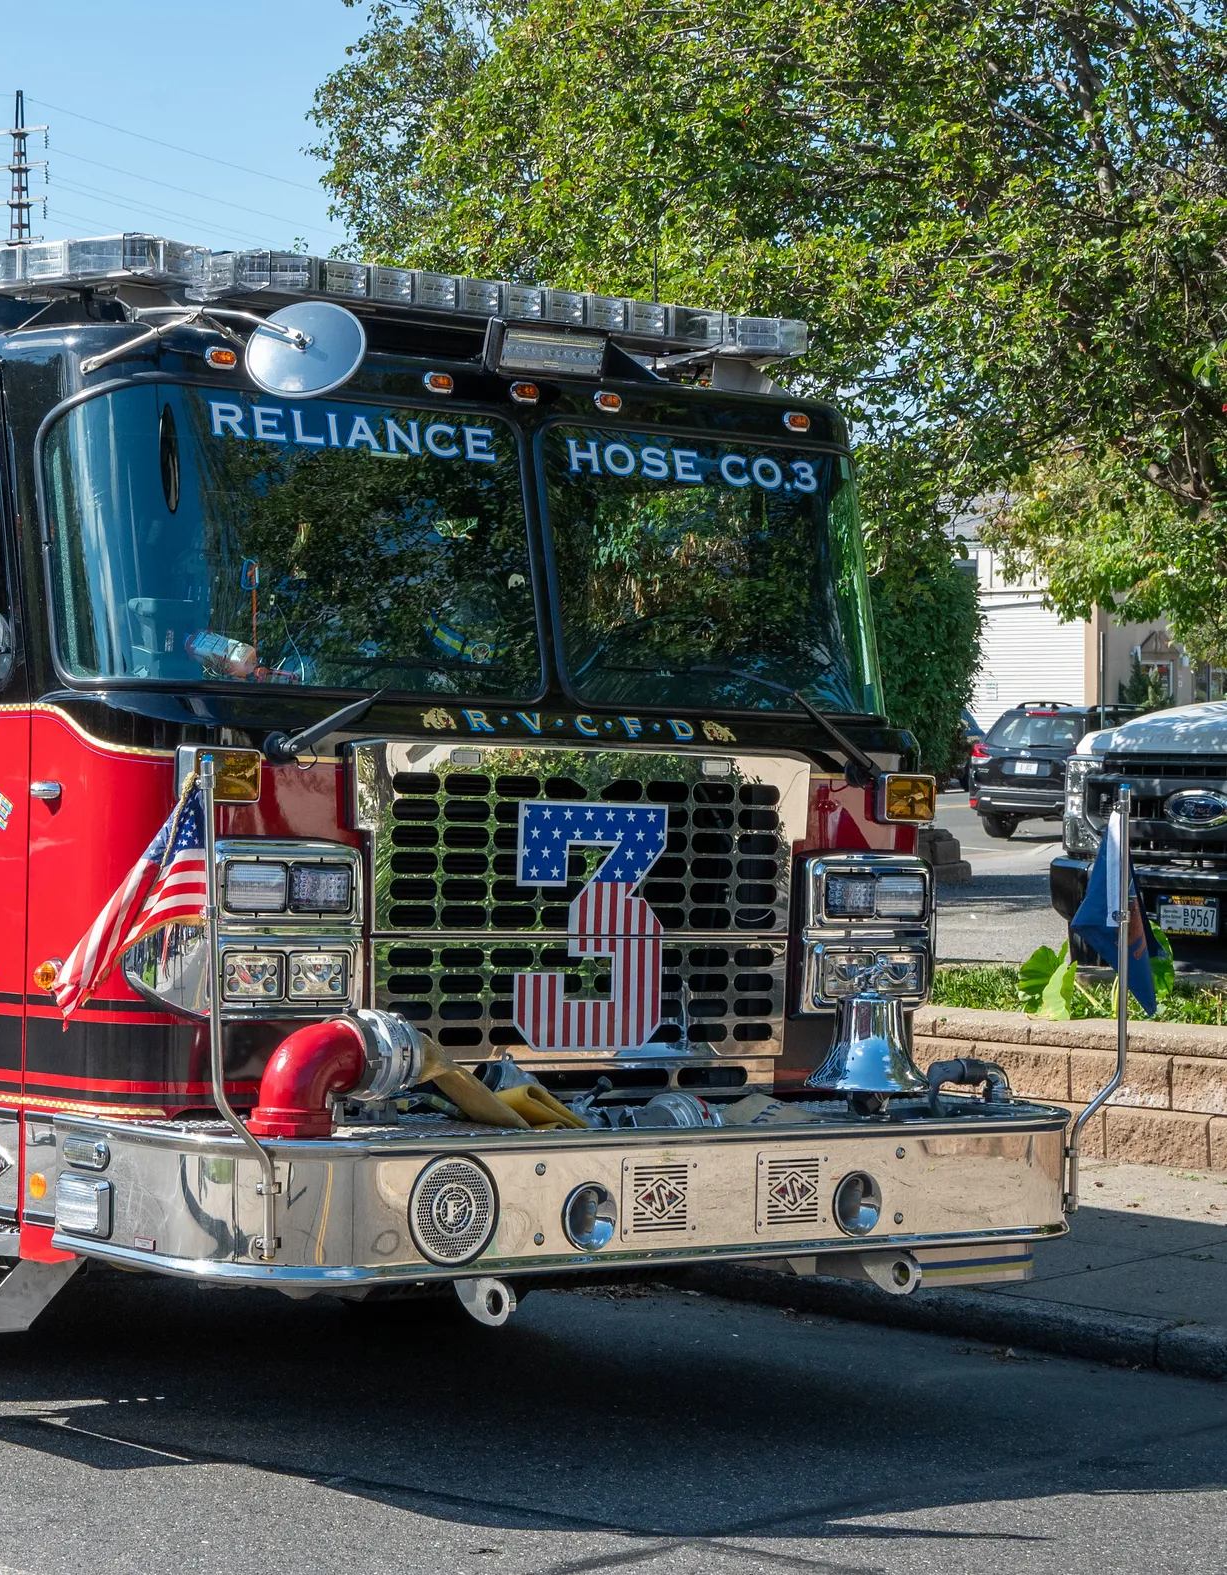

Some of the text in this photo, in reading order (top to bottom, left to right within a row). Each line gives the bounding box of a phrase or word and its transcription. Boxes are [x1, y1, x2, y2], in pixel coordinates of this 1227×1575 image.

[208, 400, 497, 463] RELIANCE
[566, 437, 703, 483] HOSE
[1179, 799, 1214, 817] Ford
[512, 800, 669, 1052] 3
[1190, 908, 1216, 929] 9567
